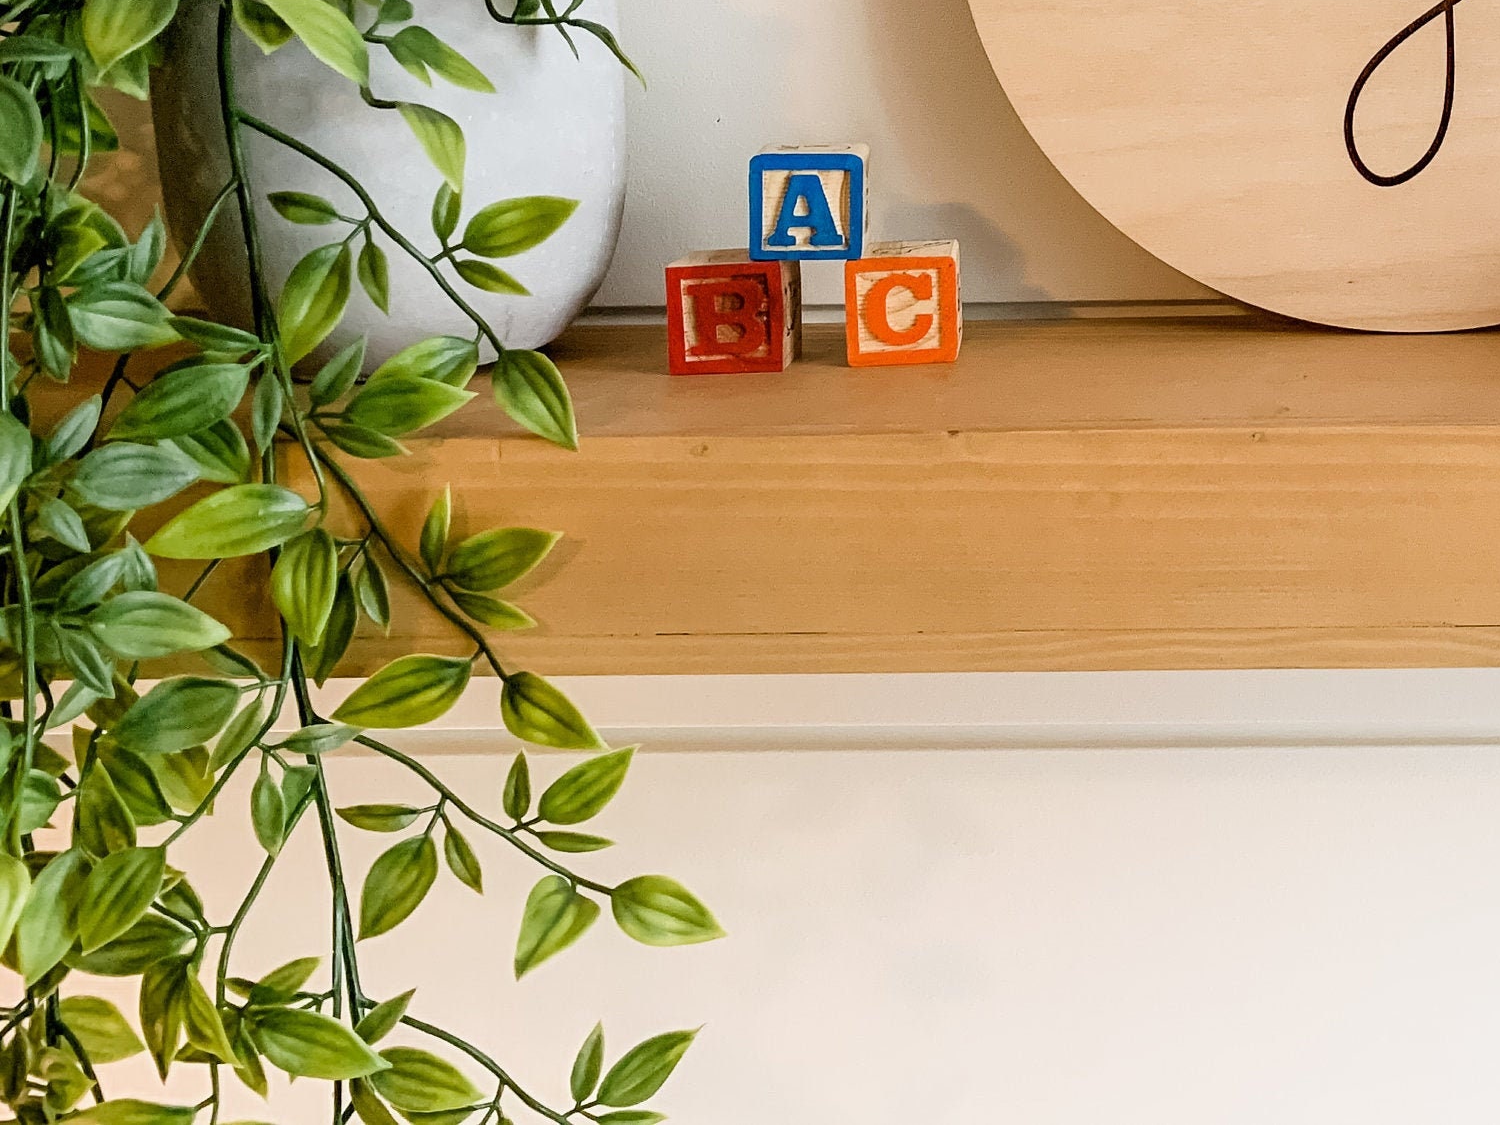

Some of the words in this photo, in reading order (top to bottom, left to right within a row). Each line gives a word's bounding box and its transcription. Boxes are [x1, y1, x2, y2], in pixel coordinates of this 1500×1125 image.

[767, 173, 844, 247] A
[685, 278, 768, 357] B
[865, 273, 934, 347] C
